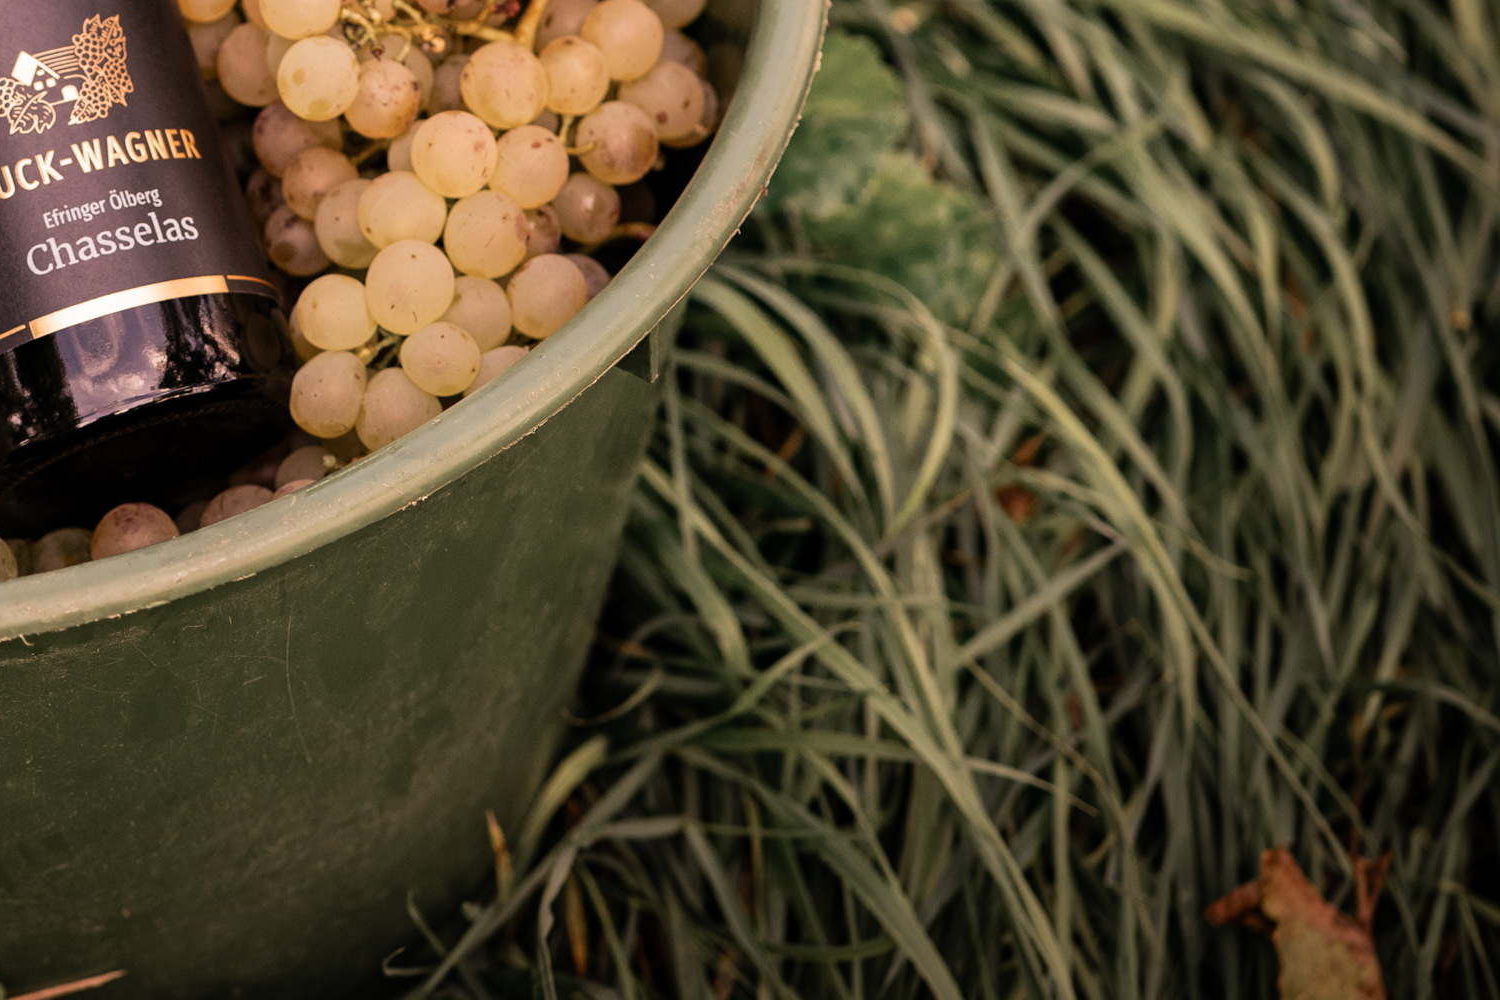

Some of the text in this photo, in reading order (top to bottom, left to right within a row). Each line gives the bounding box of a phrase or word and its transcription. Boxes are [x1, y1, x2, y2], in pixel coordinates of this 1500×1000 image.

[42, 188, 162, 229] Efringer Ölberg
[26, 211, 199, 276] Chasselas
